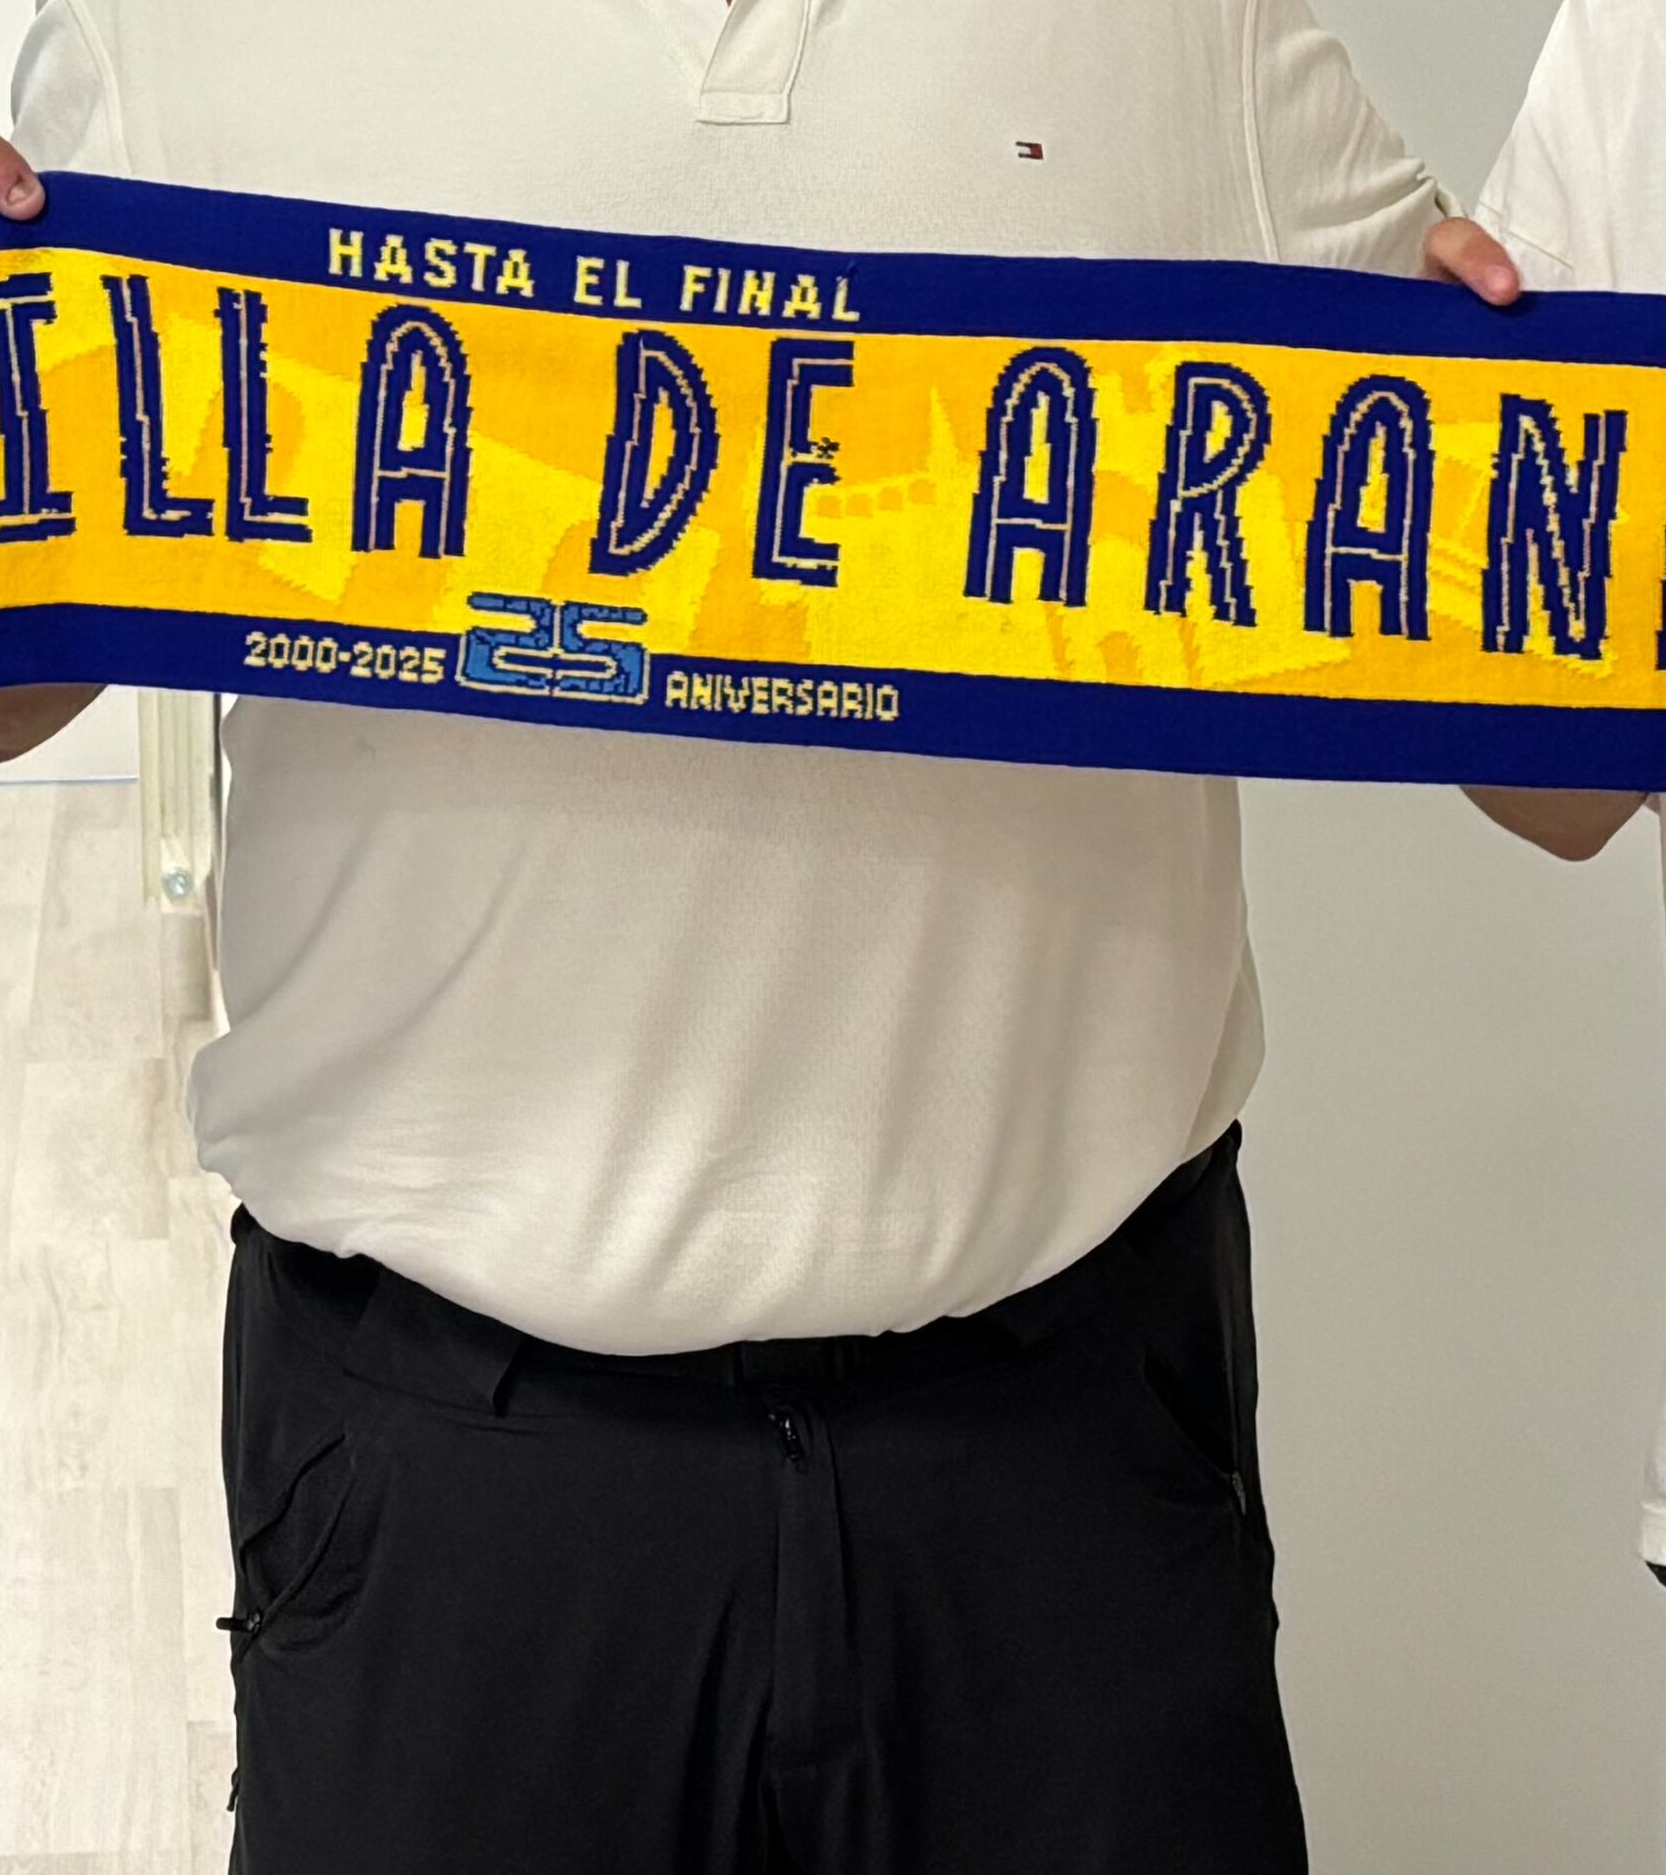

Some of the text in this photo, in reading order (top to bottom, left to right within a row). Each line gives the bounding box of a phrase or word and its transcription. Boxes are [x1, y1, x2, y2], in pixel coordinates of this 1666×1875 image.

[329, 228, 860, 322] HASTA EL FINAL
[590, 329, 855, 587] DE
[244, 632, 446, 684] 2000-2025
[454, 590, 651, 705] 25
[664, 670, 900, 722] ANIVERSARIO
